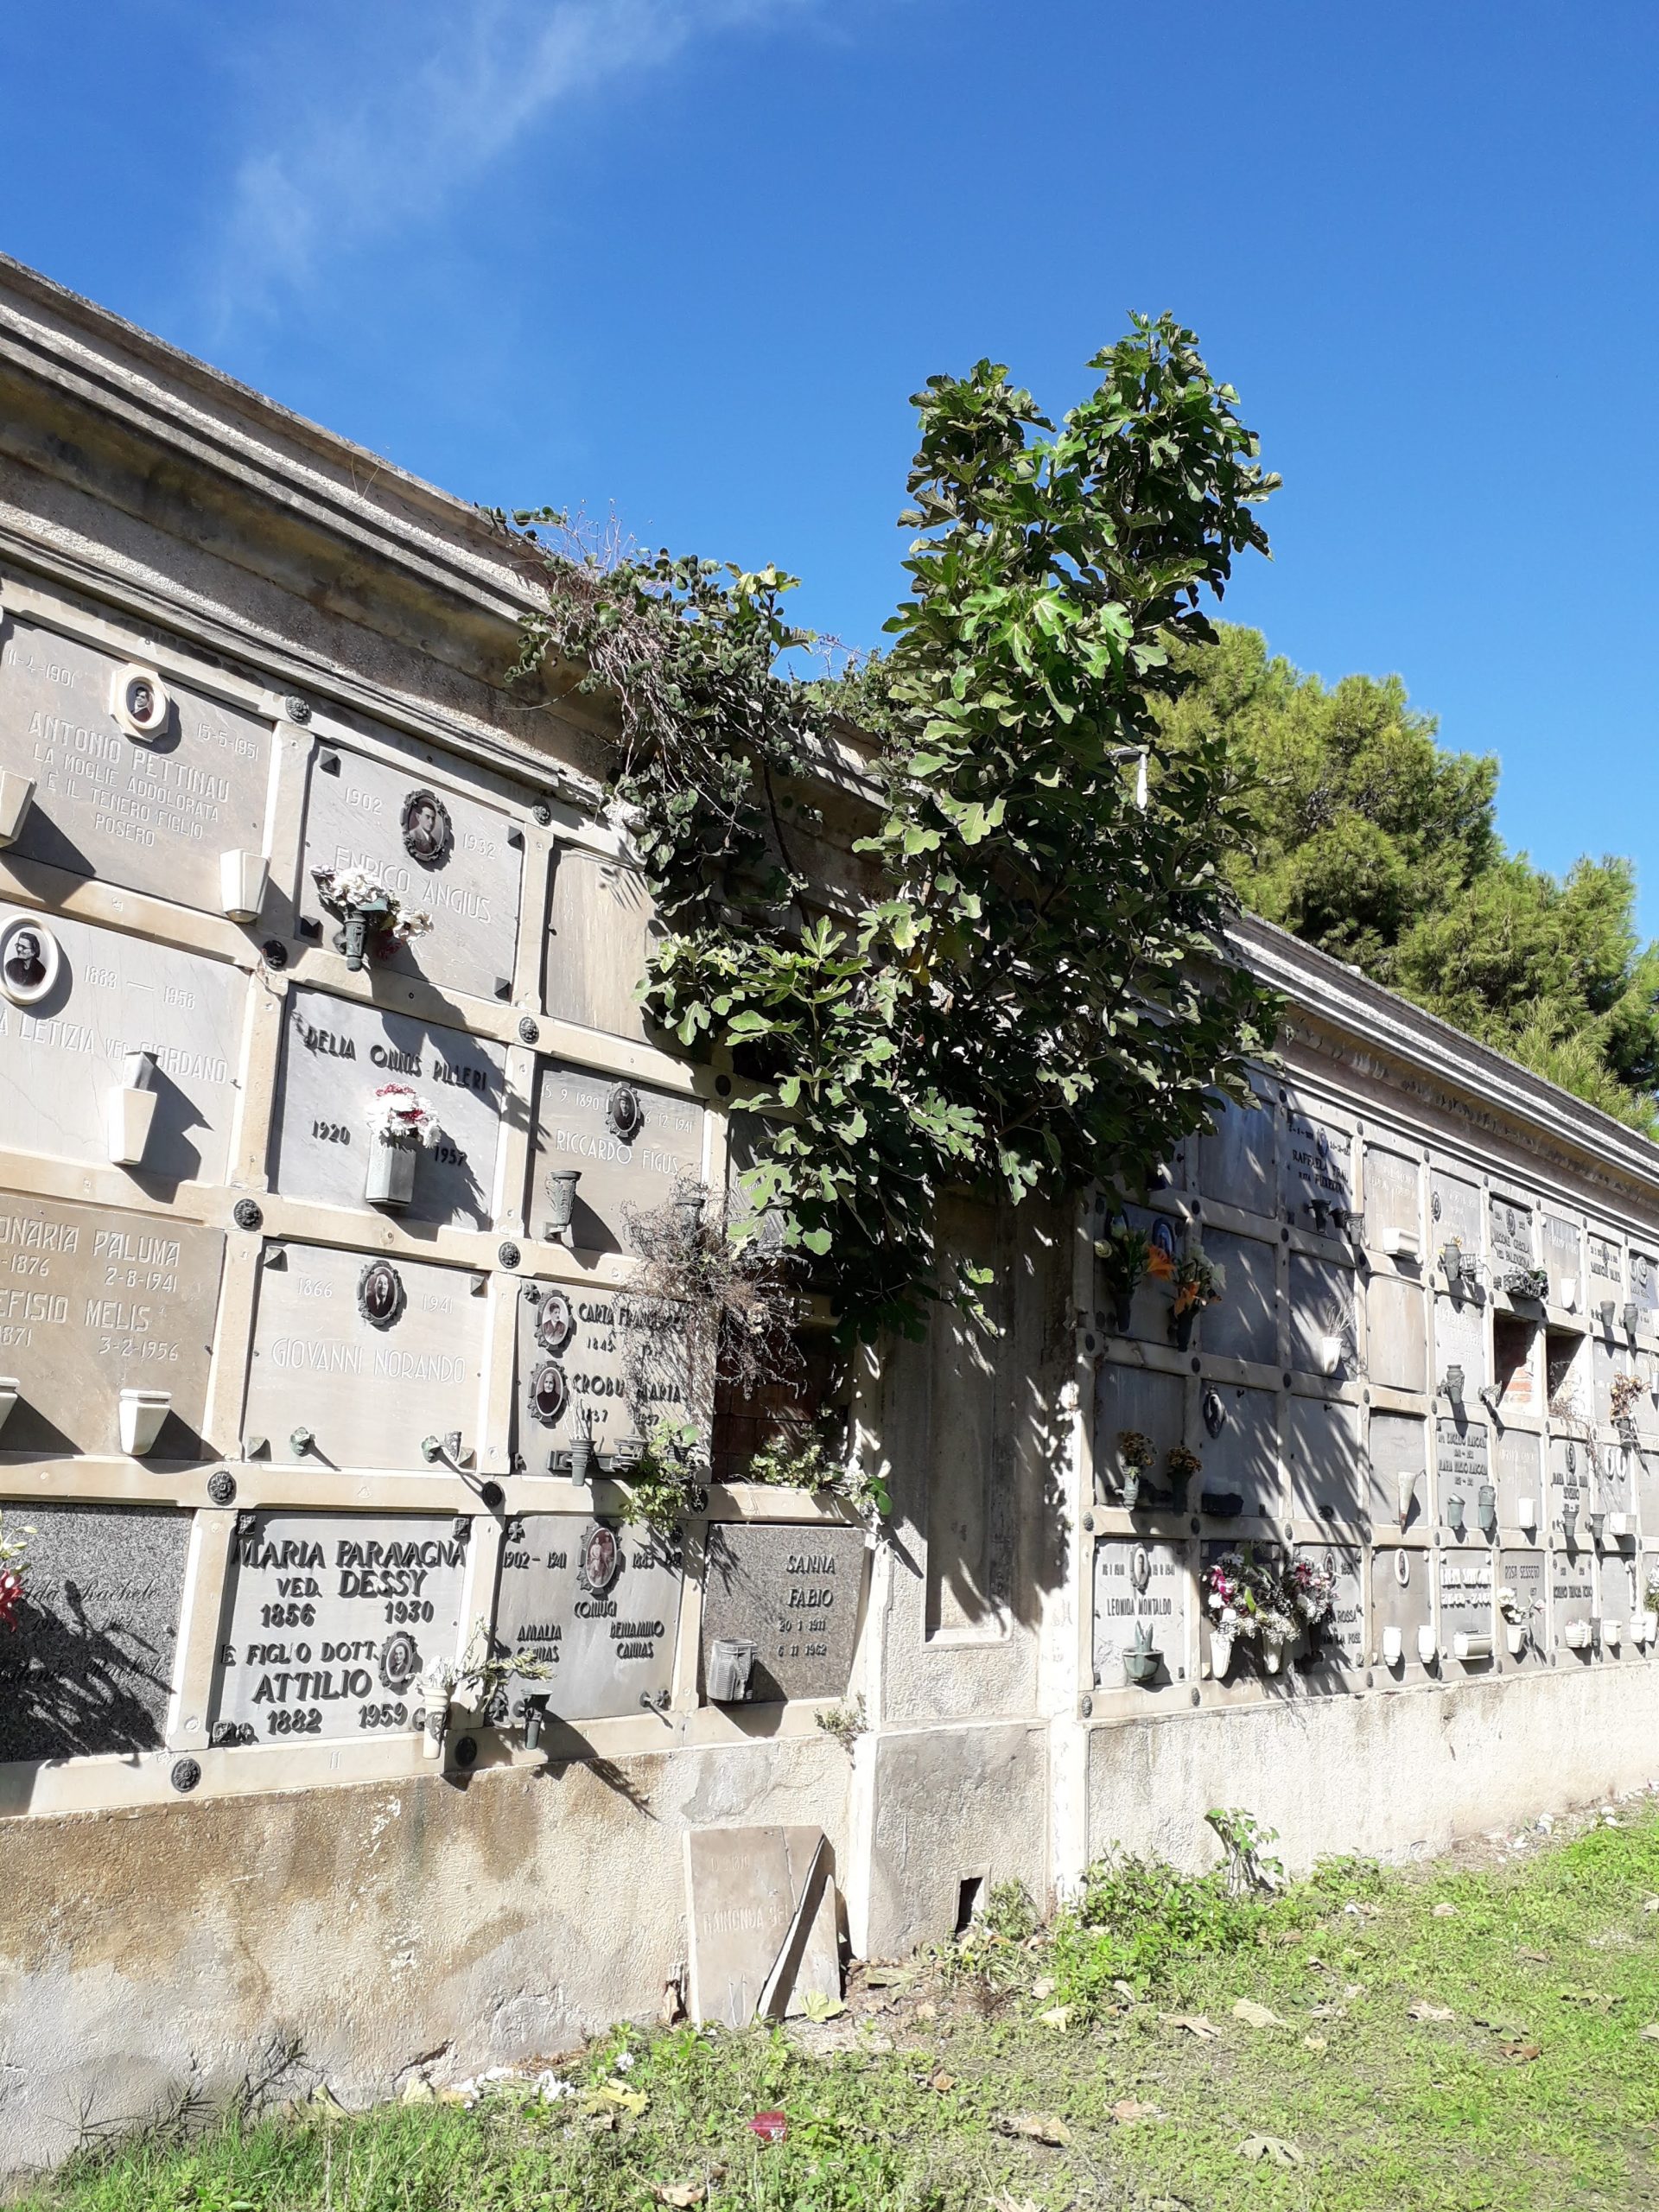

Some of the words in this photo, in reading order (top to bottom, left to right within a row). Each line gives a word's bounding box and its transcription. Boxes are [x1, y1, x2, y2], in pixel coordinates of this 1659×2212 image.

[7, 649, 75, 689] 11-4-1901
[198, 722, 259, 761] 15-5-1951
[29, 710, 121, 765] ANTONIO
[131, 747, 229, 803] PETTINAU
[33, 743, 54, 766] LA
[64, 753, 118, 787] MOGLIE
[127, 777, 219, 823] ADDOLORATA
[67, 779, 79, 798] IL
[91, 786, 149, 821] TENERO
[157, 810, 203, 840] FIGLIO
[346, 787, 383, 815] 1902
[95, 813, 155, 847] POSERO
[463, 833, 497, 860] 1932
[334, 845, 411, 894] ENRICO
[423, 880, 492, 925] ANGIUS
[163, 986, 195, 1009] 1958
[19, 1012, 95, 1054] LETIZIA
[305, 1025, 356, 1061] DELIA
[370, 1044, 423, 1077] ONNIS
[432, 1060, 486, 1090] PILLERI
[575, 1092, 599, 1111] 1890
[312, 1119, 351, 1146] 1920
[675, 1118, 692, 1135] 1941
[435, 1146, 467, 1166] 1957
[556, 1128, 632, 1165] RICCARDO
[642, 1149, 678, 1176] FIGUS
[92, 1230, 181, 1267] PALUMA
[105, 1266, 177, 1293] 2-8-1941
[297, 1278, 333, 1298] 1866
[85, 1299, 151, 1332] MELIS
[423, 1294, 454, 1314] 1941
[99, 1336, 180, 1361] 3-2-1956
[271, 1338, 363, 1374] GIOVANNI
[374, 1348, 466, 1383] NORANDO
[235, 1539, 326, 1569] MARIA
[335, 1540, 467, 1568] PARAVAGNA
[503, 1551, 531, 1569] 1902
[785, 1554, 836, 1574] SANNA
[338, 1569, 429, 1599] DESSY
[786, 1587, 834, 1607] FABIO
[261, 1603, 316, 1628] 1856
[385, 1600, 434, 1624] 1930
[574, 1600, 618, 1618] CONIUGI
[1107, 1598, 1135, 1616] LEONIDA
[1138, 1598, 1171, 1615] MONTALDO
[517, 1623, 563, 1642] AMALIA
[610, 1620, 665, 1639] BENIAMINO
[220, 1644, 236, 1666] E
[616, 1643, 654, 1659] CANNAS
[251, 1669, 372, 1704] ATTILIO
[267, 1707, 322, 1735] 1882
[358, 1701, 409, 1729] 1959
